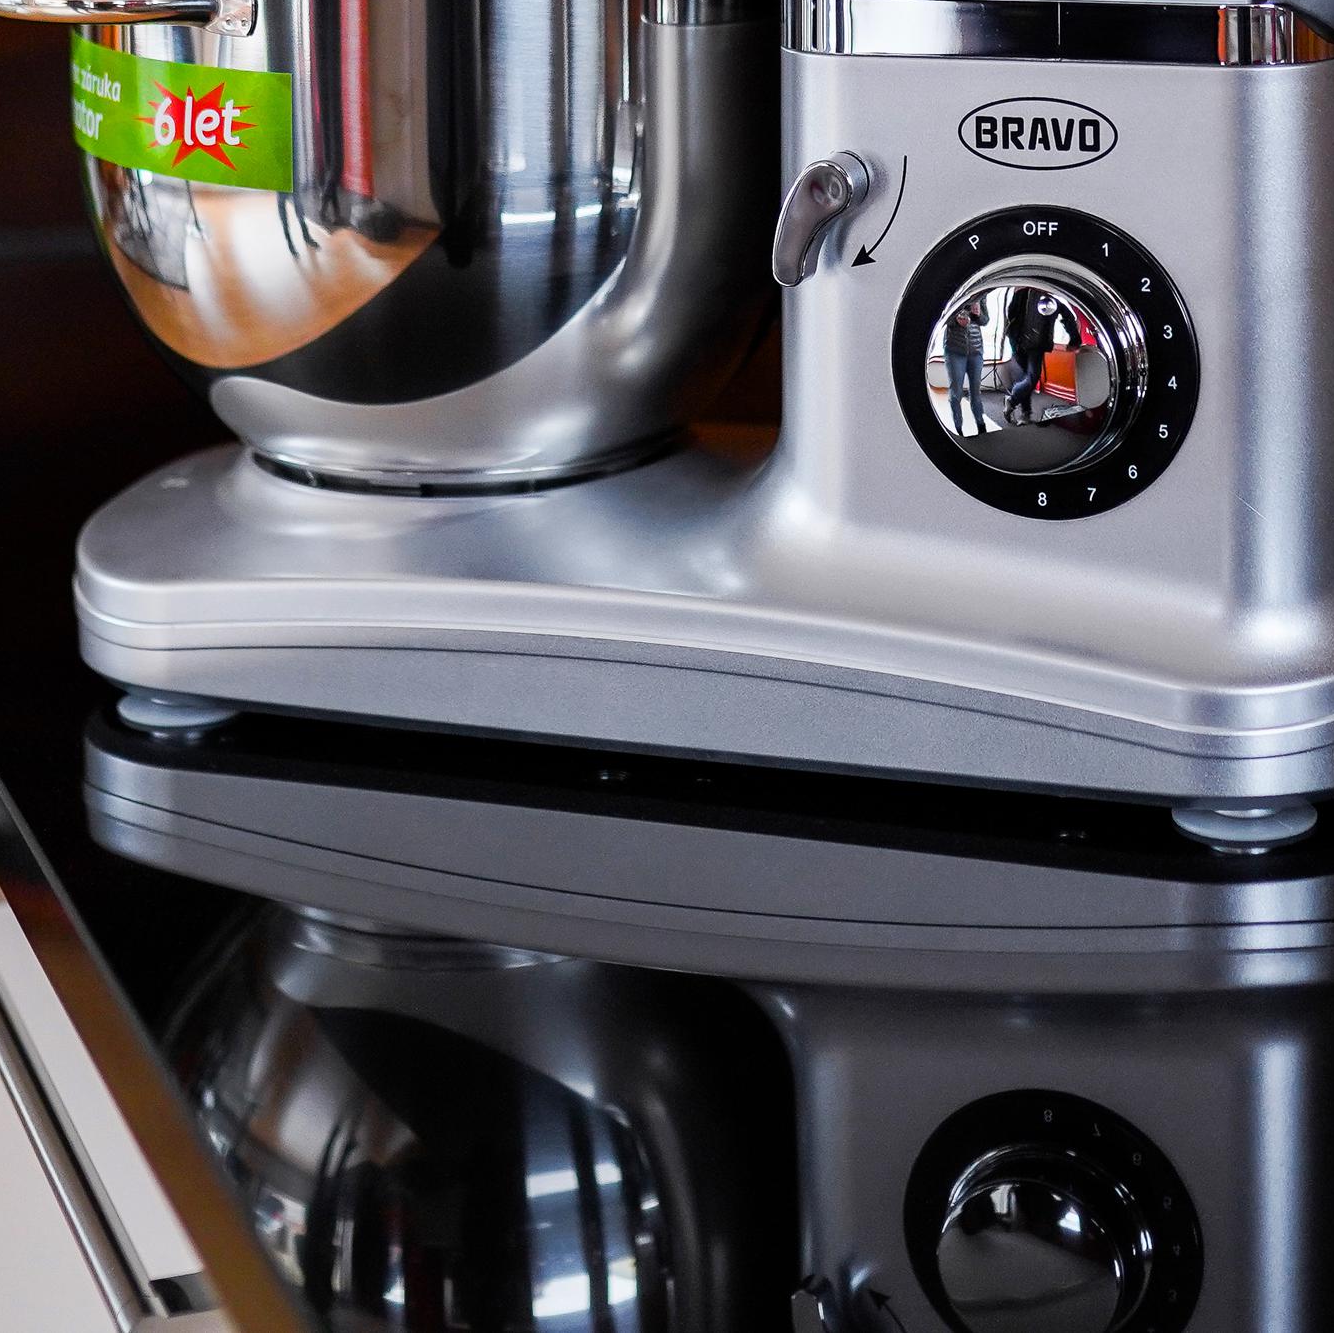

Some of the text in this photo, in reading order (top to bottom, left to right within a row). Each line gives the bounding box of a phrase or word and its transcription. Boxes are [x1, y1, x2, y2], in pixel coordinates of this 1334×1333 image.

[154, 95, 242, 146] 6 let
[974, 114, 1102, 154] BRAVO
[968, 220, 1178, 507] P OFF 1 2 3 4 5 6 7 8
